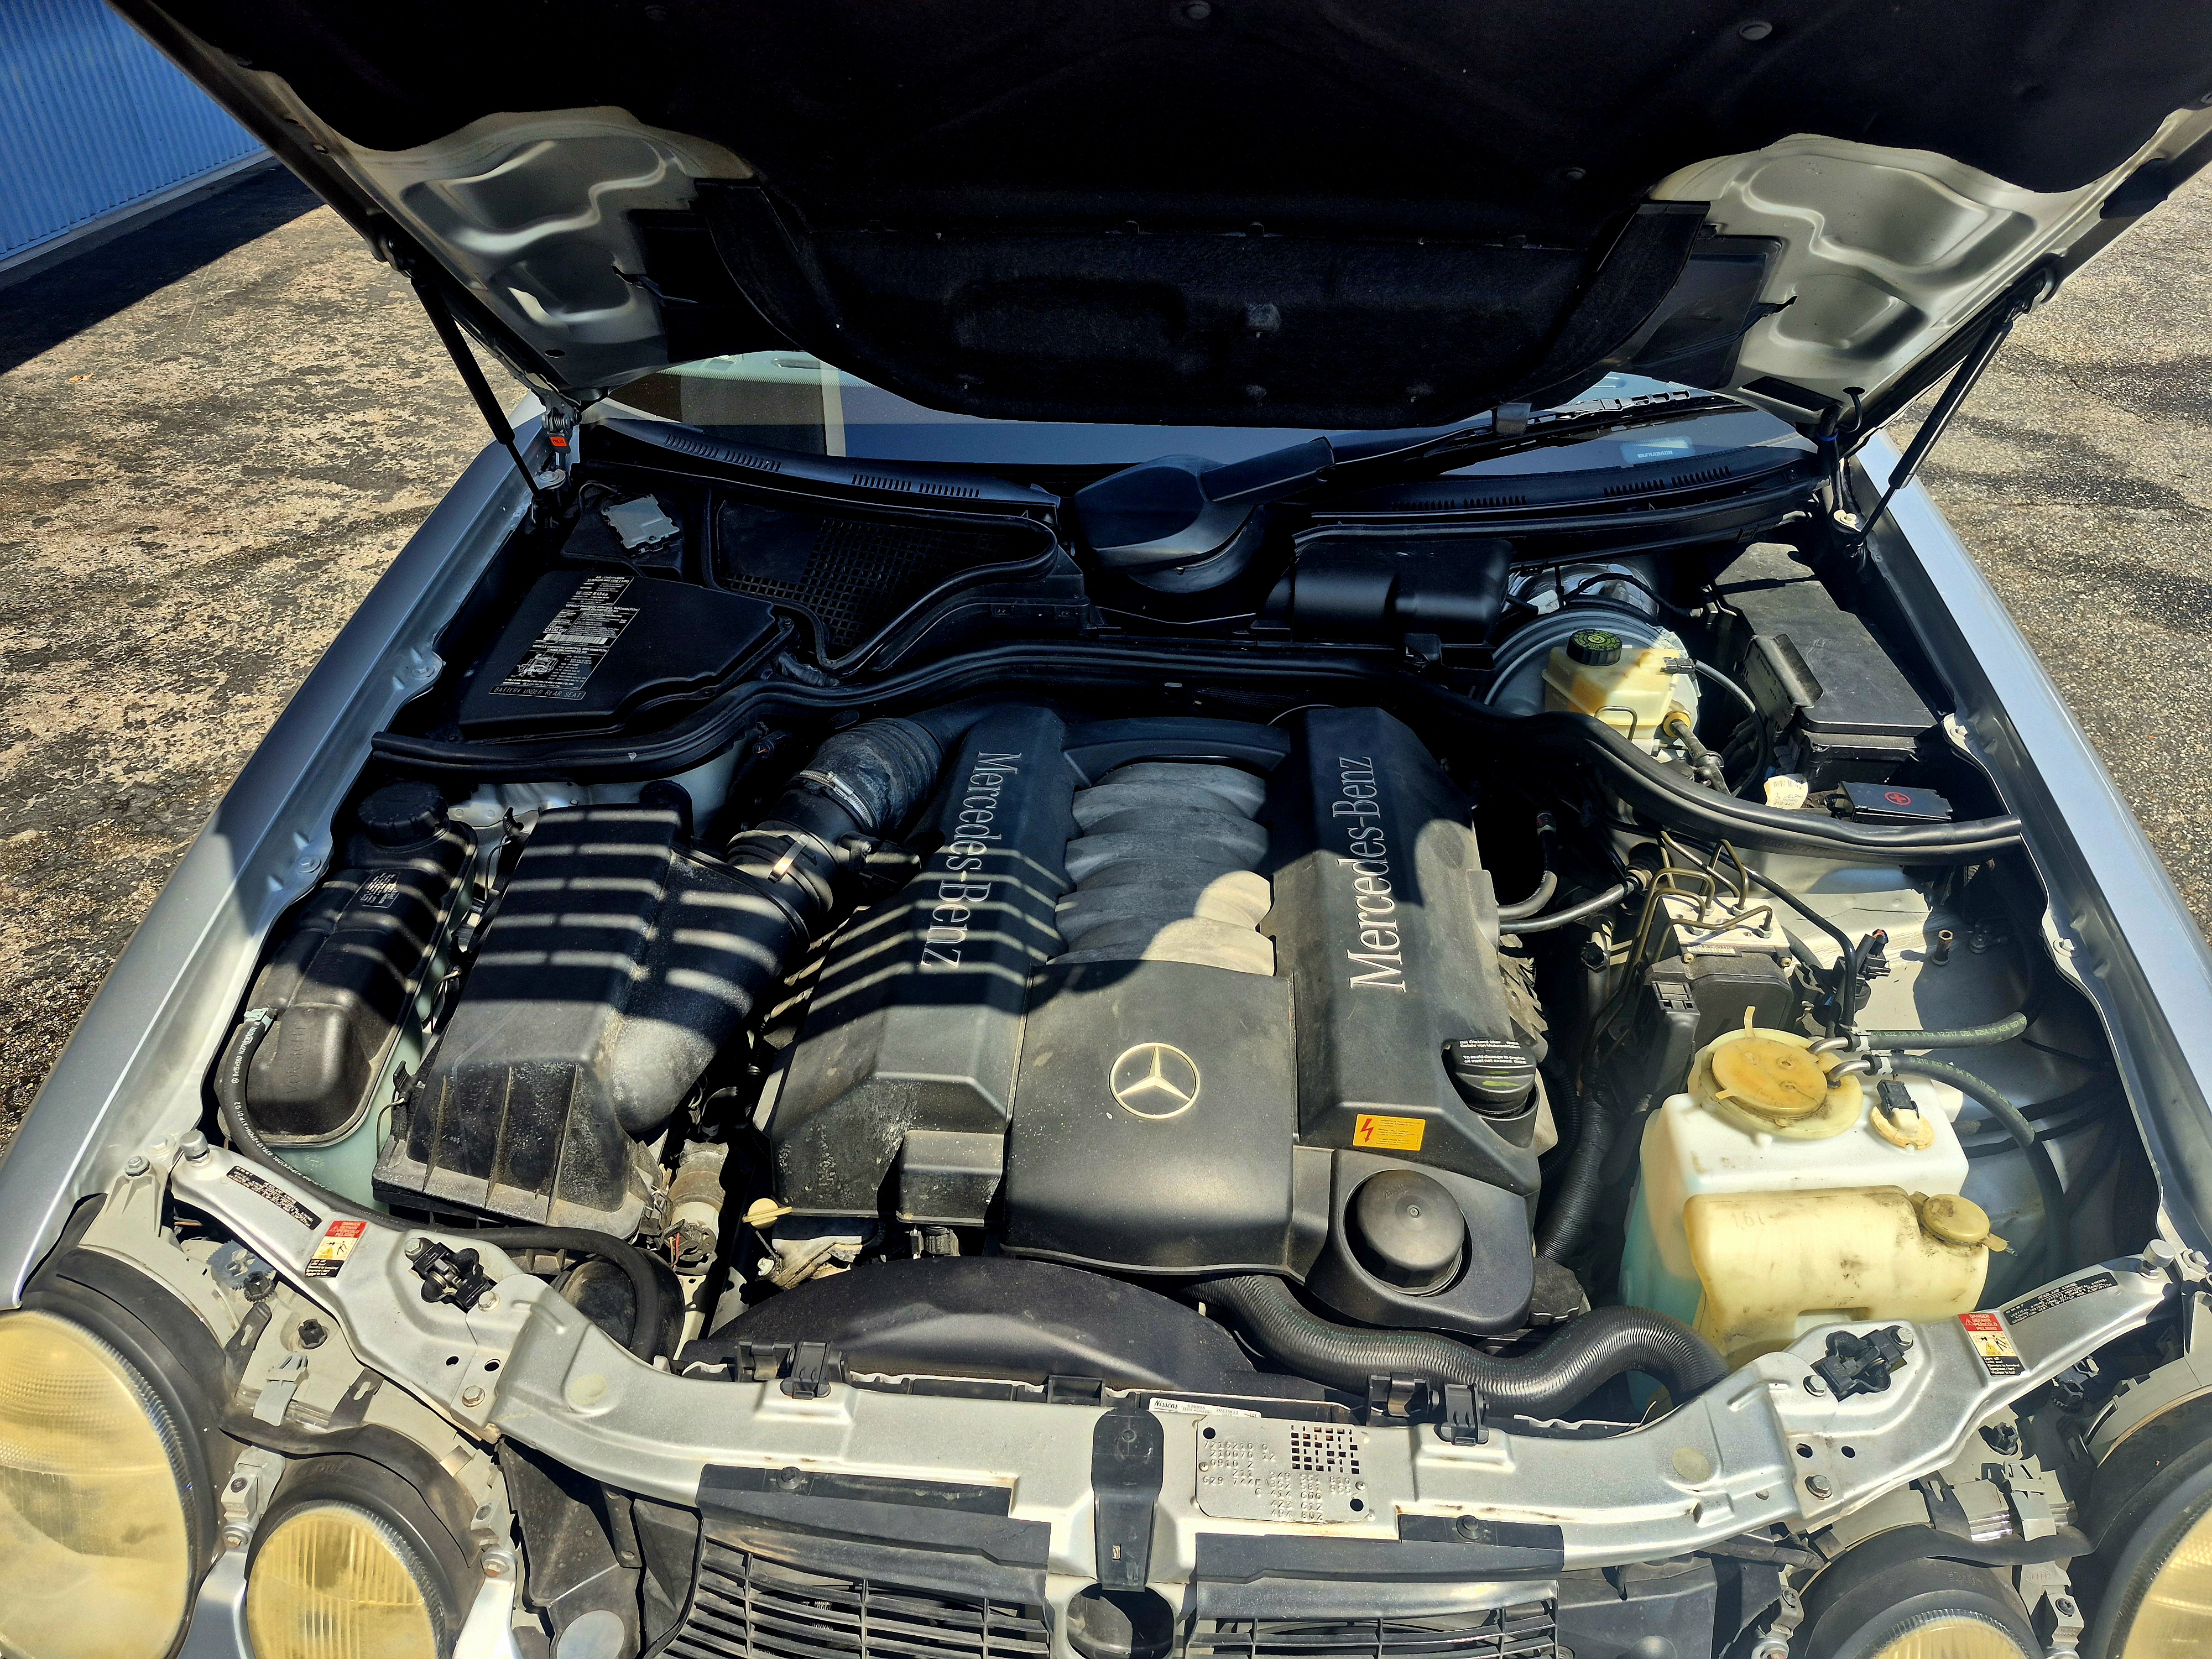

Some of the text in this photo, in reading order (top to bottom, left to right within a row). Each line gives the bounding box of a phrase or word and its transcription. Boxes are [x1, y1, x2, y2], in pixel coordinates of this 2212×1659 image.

[920, 750, 1022, 968] Mercedes-Benz
[1332, 756, 1407, 993] Mercedes-Benz
[1974, 1028, 1997, 1036] 6254.12
[1998, 1025, 2010, 1033] KEK
[2037, 1282, 2078, 1301] HEADLAMP AIMING
[2010, 1307, 2029, 1318] VERTICAL
[1154, 1399, 1178, 1410] Nissens
[1262, 1452, 1276, 1462] 12
[1248, 1460, 1254, 1470] 2
[1233, 1469, 1254, 1479] 211
[1270, 1489, 1292, 1499] 414
[1271, 1500, 1323, 1513] 423 612
[1271, 1509, 1293, 1519] 494
